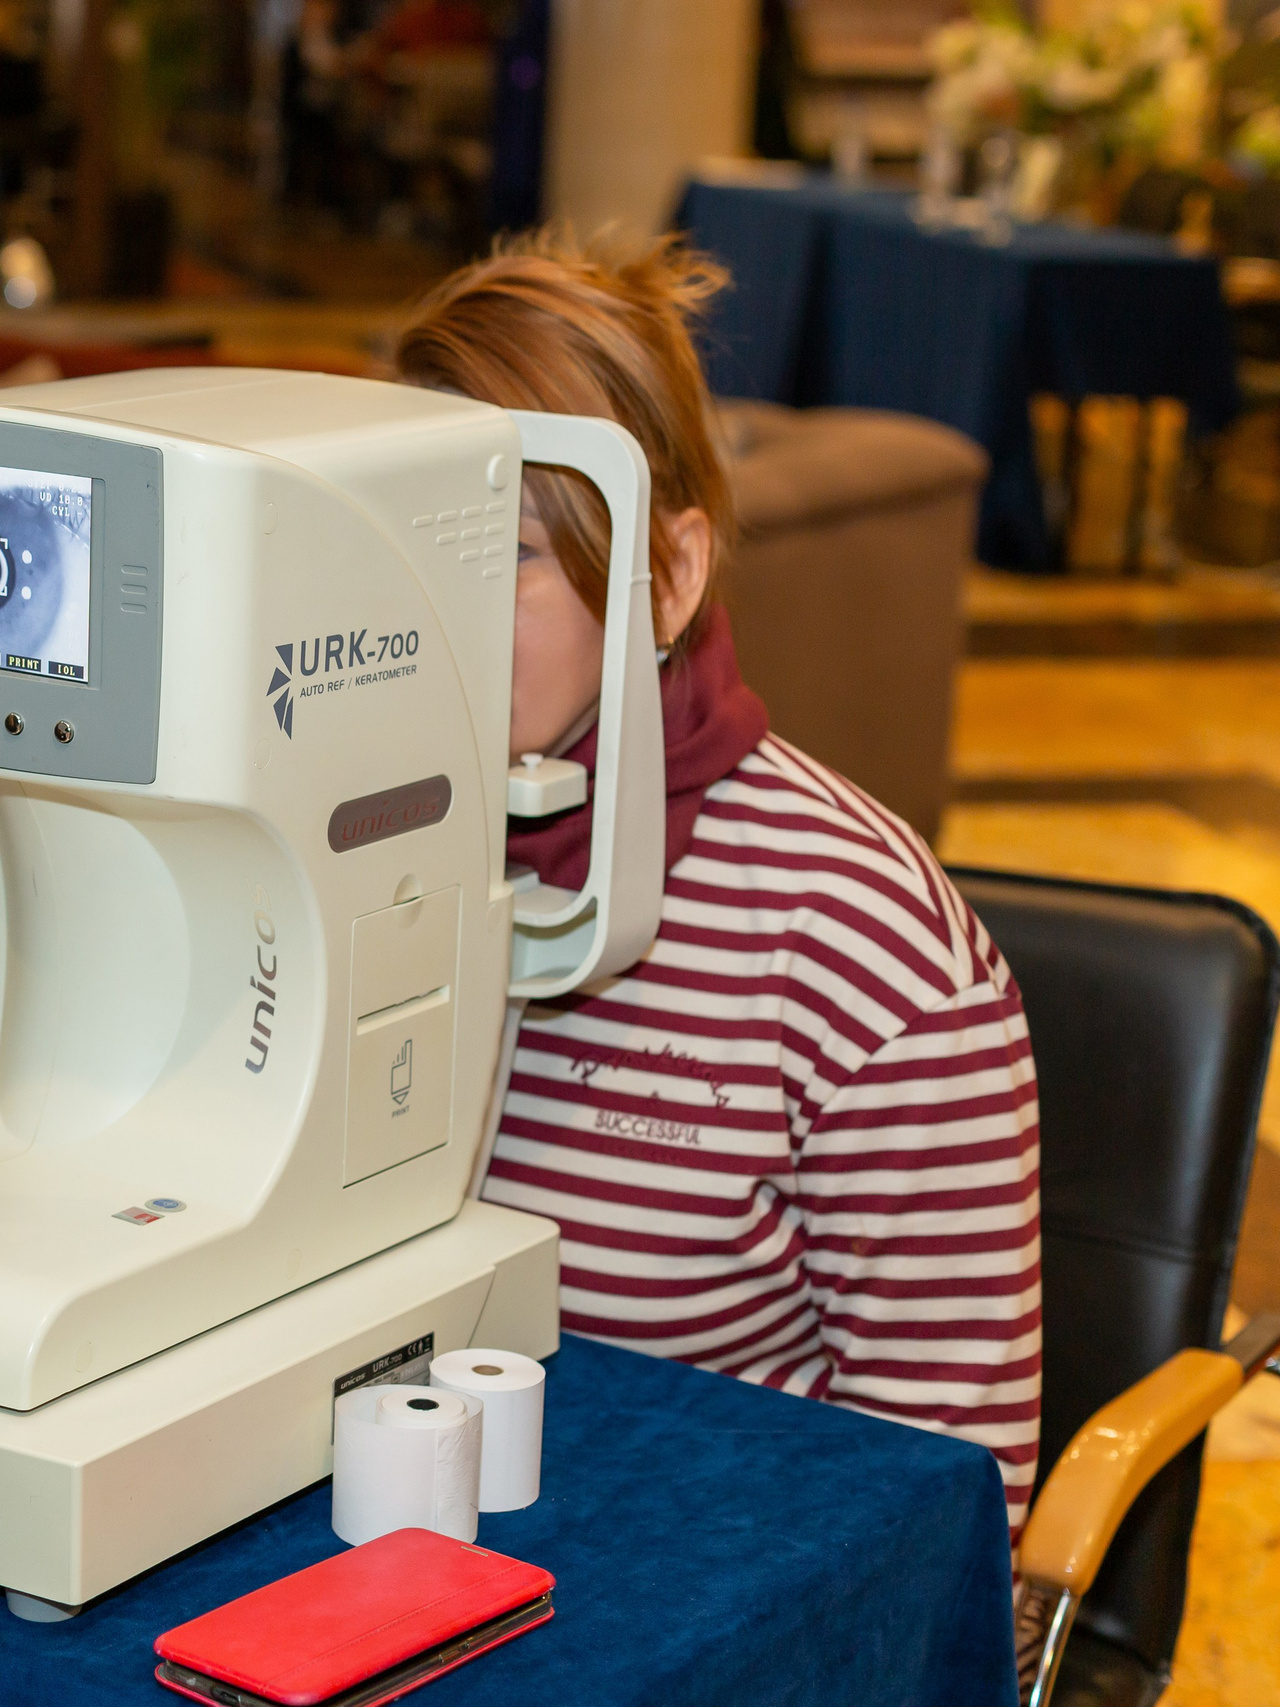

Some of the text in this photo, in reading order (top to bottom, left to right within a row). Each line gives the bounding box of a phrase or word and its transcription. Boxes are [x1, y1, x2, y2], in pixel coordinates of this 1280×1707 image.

[40, 491, 83, 507] VD 10.0
[51, 505, 70, 518] CYL
[9, 656, 39, 671] PRINT
[57, 664, 76, 677] IOL
[299, 628, 419, 676] URK-700
[300, 683, 325, 698] AUTO
[327, 679, 345, 692] REF
[355, 664, 417, 687] KERATOMETER
[341, 797, 440, 842] unicos
[594, 1108, 702, 1145] SUCCESSFUL
[340, 1372, 366, 1390] unicos
[372, 1353, 403, 1373] URK-700
